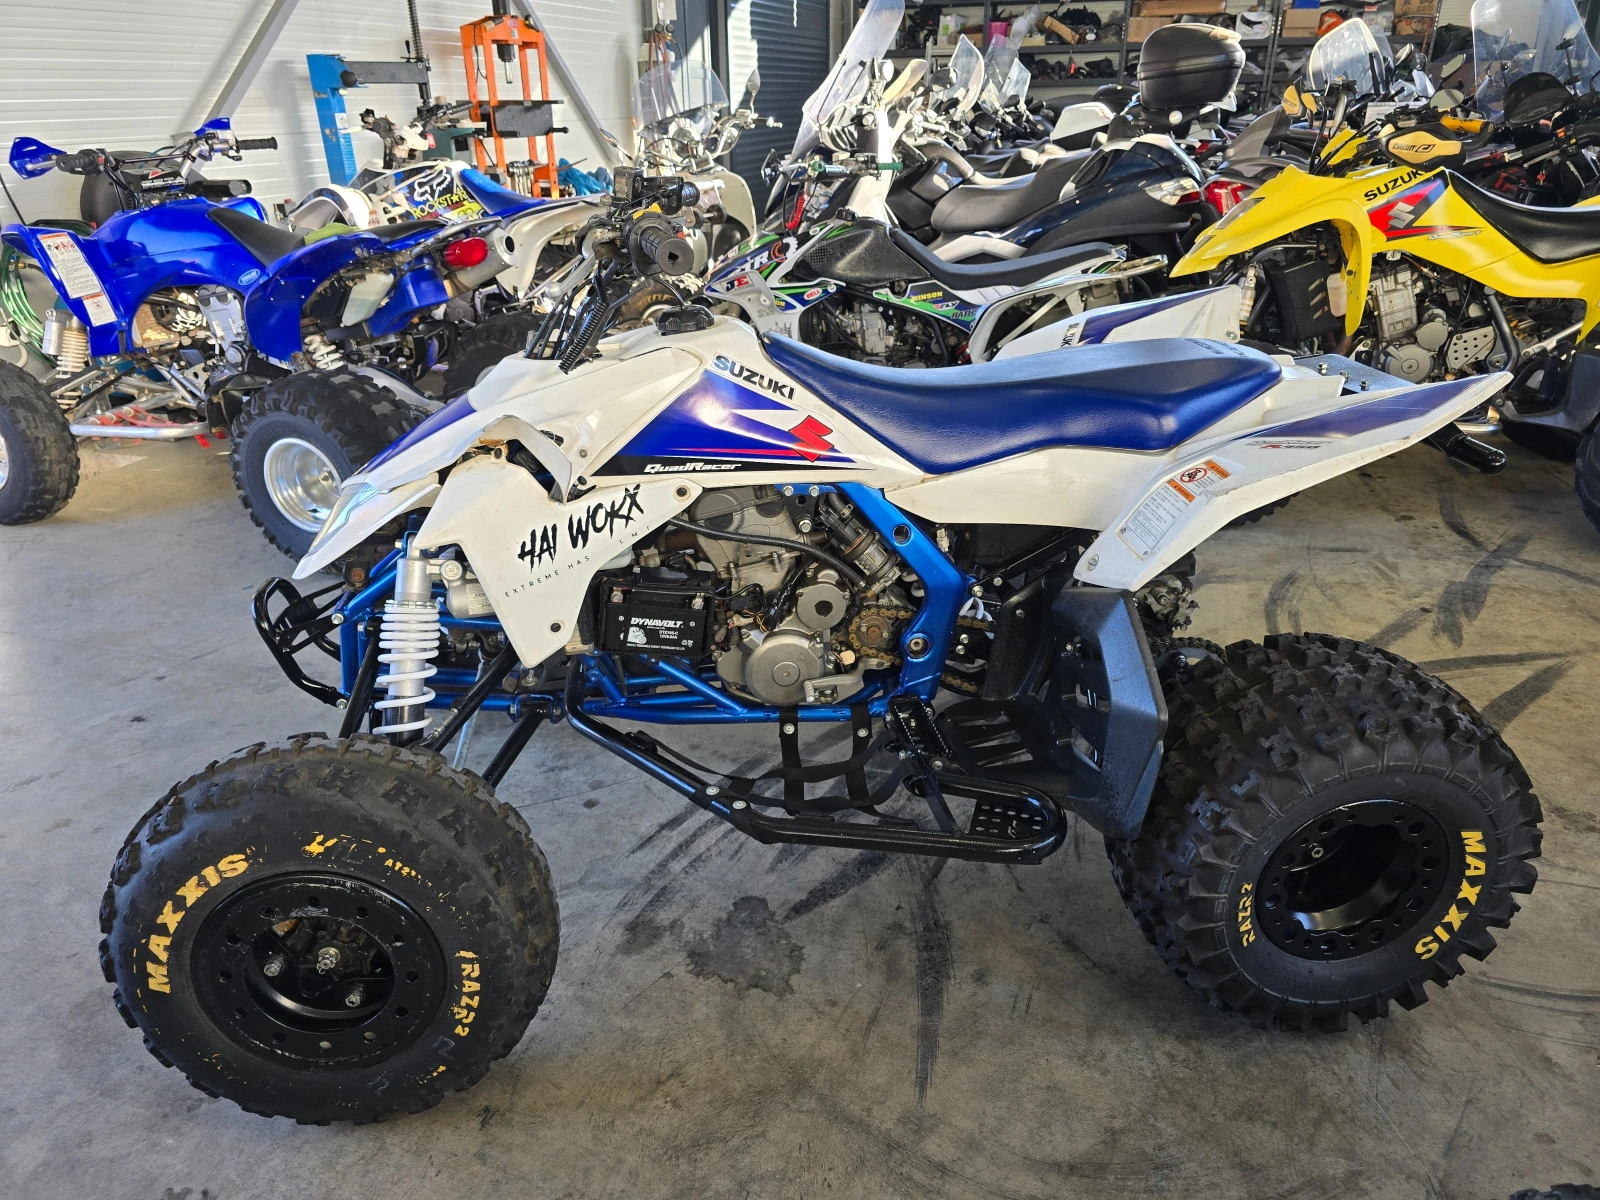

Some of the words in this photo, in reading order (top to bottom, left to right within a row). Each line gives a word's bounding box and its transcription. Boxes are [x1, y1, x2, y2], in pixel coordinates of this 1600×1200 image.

[1363, 168, 1426, 202] SUZUK
[725, 274, 750, 292] JE
[805, 288, 821, 300] BELL
[712, 354, 796, 401] SUZUKI
[643, 461, 743, 475] QuadRacer
[504, 569, 560, 598] EXTREME
[567, 555, 590, 570] HAS
[630, 617, 684, 629] DYNAVOLT
[1414, 831, 1487, 960] MAXXIS
[146, 853, 249, 994] MAXXIS
